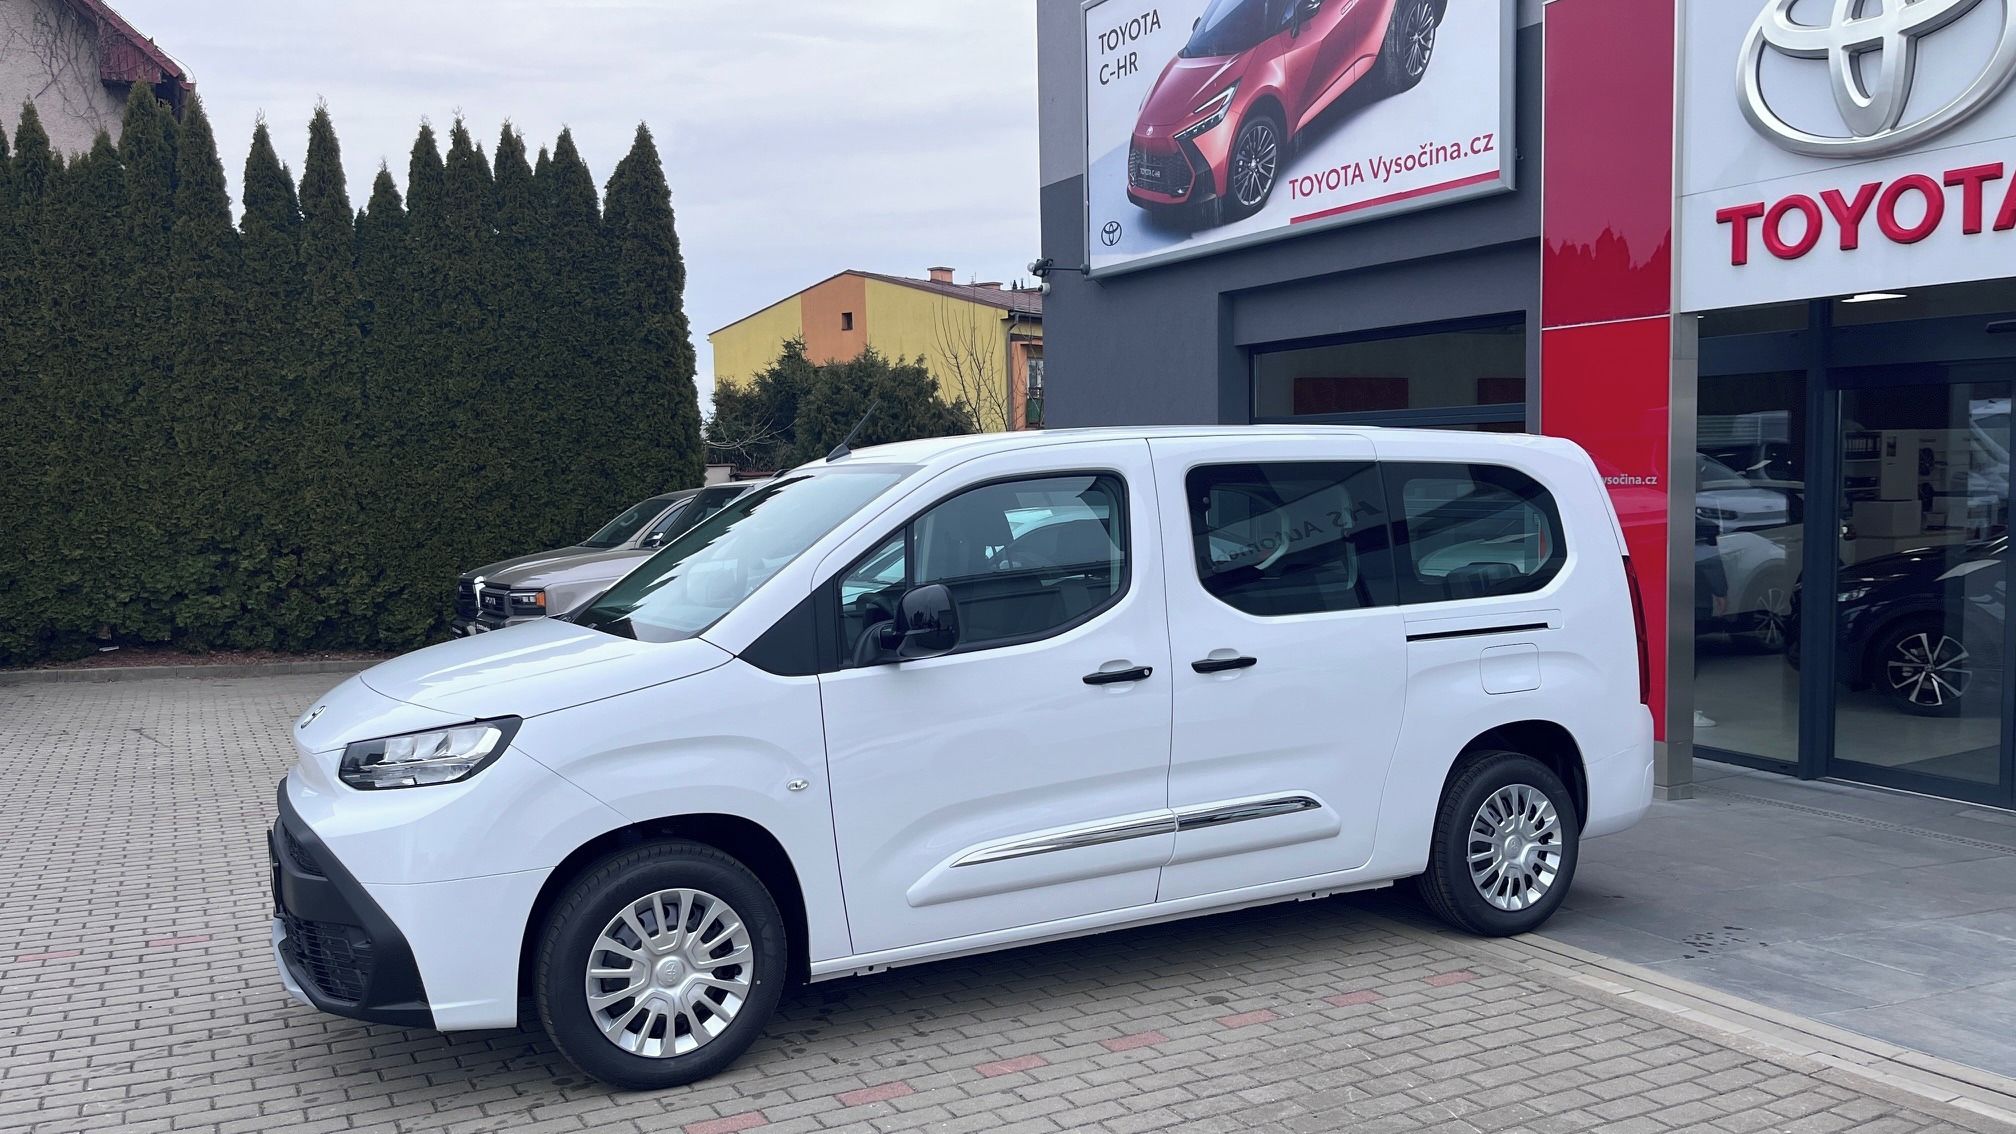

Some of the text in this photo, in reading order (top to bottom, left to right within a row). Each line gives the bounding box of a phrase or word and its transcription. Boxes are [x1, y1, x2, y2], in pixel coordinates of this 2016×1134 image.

[1098, 9, 1161, 55] TOYOTA
[1099, 52, 1138, 85] C-HR
[1288, 133, 1494, 200] TOYOTA Vysočina.cz
